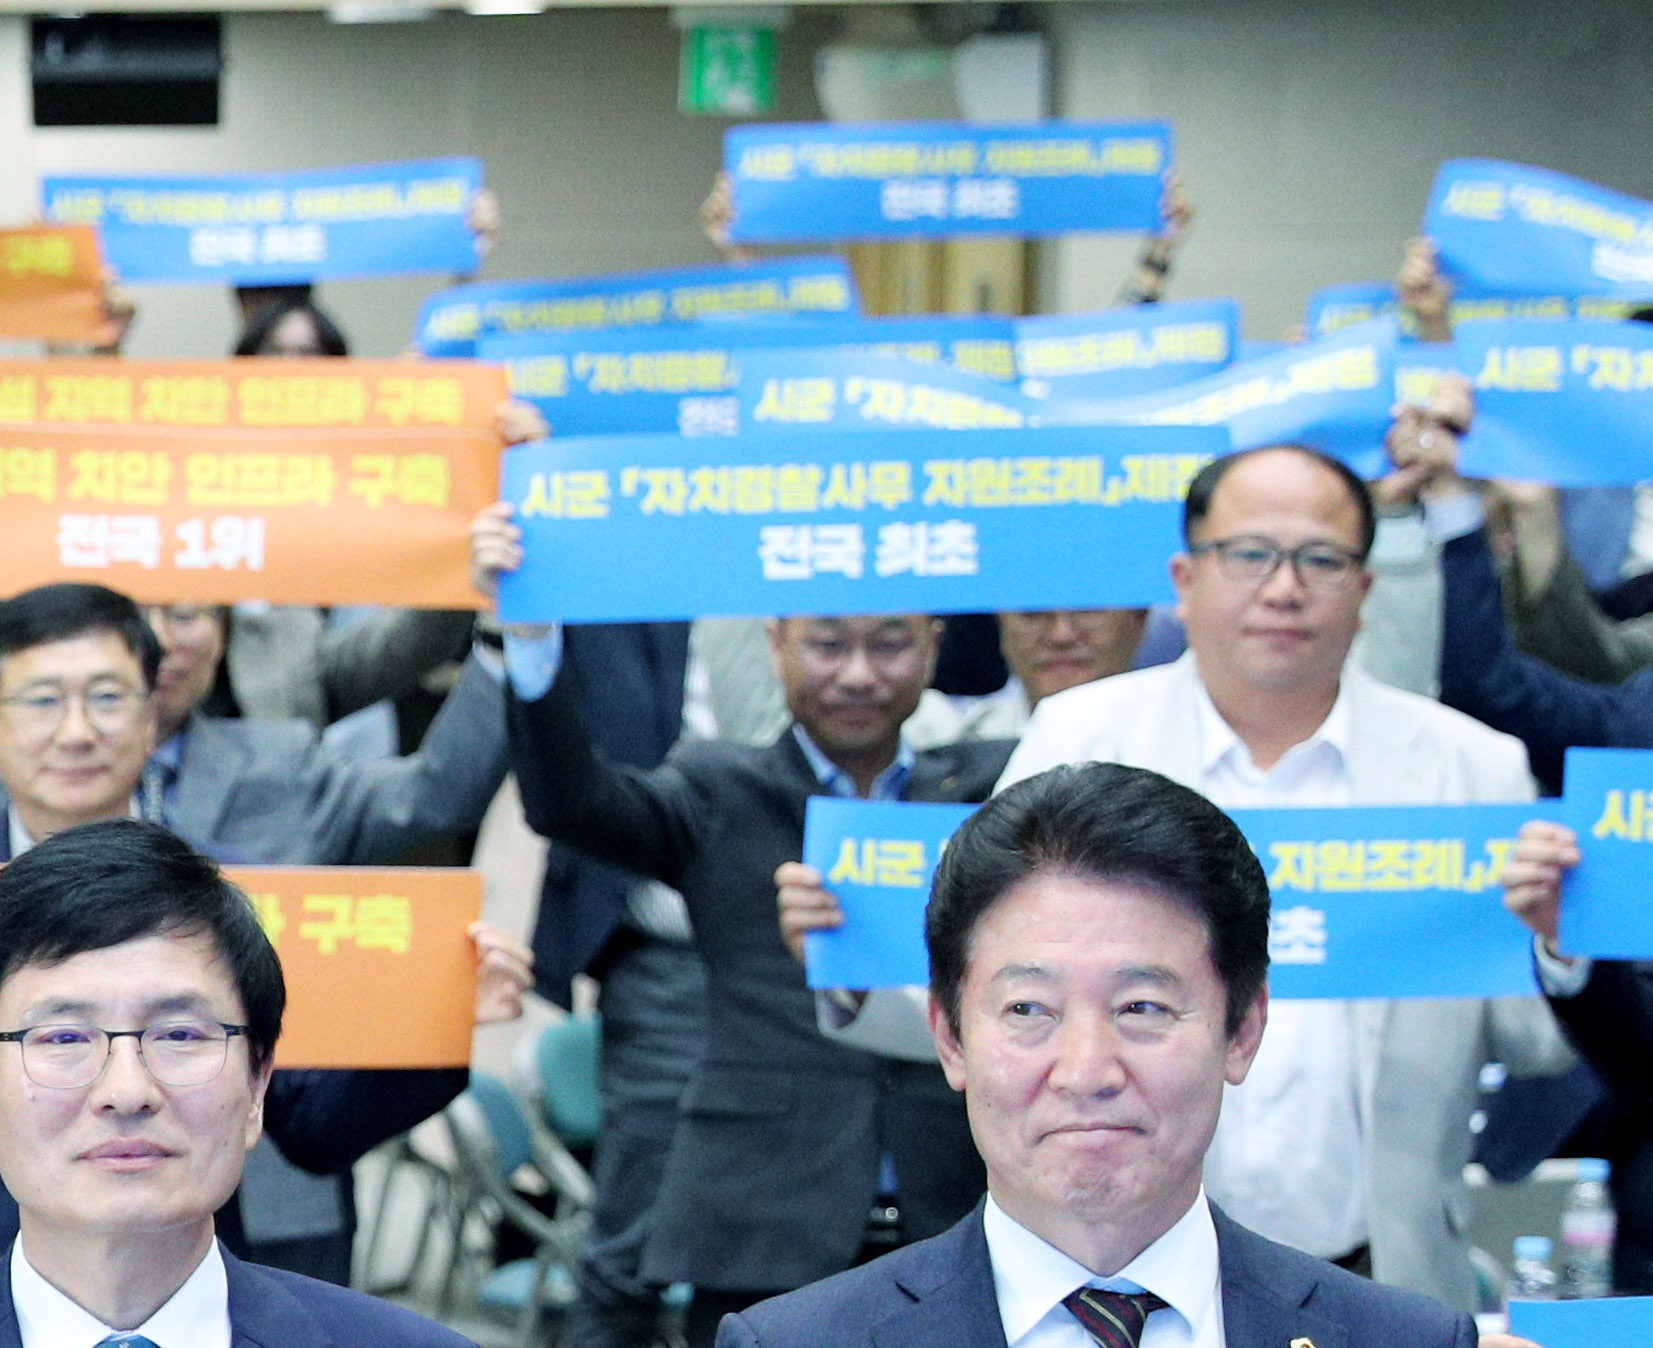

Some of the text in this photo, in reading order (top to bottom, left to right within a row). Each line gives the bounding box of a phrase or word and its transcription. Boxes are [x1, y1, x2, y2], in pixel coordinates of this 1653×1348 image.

[69, 450, 171, 505] 치안
[183, 453, 337, 506] 인프라
[348, 454, 451, 509] 구축
[56, 513, 266, 570] 전국 1위
[758, 520, 979, 581] 전국 최초
[828, 838, 926, 888] 시군
[299, 893, 414, 953] 구축
